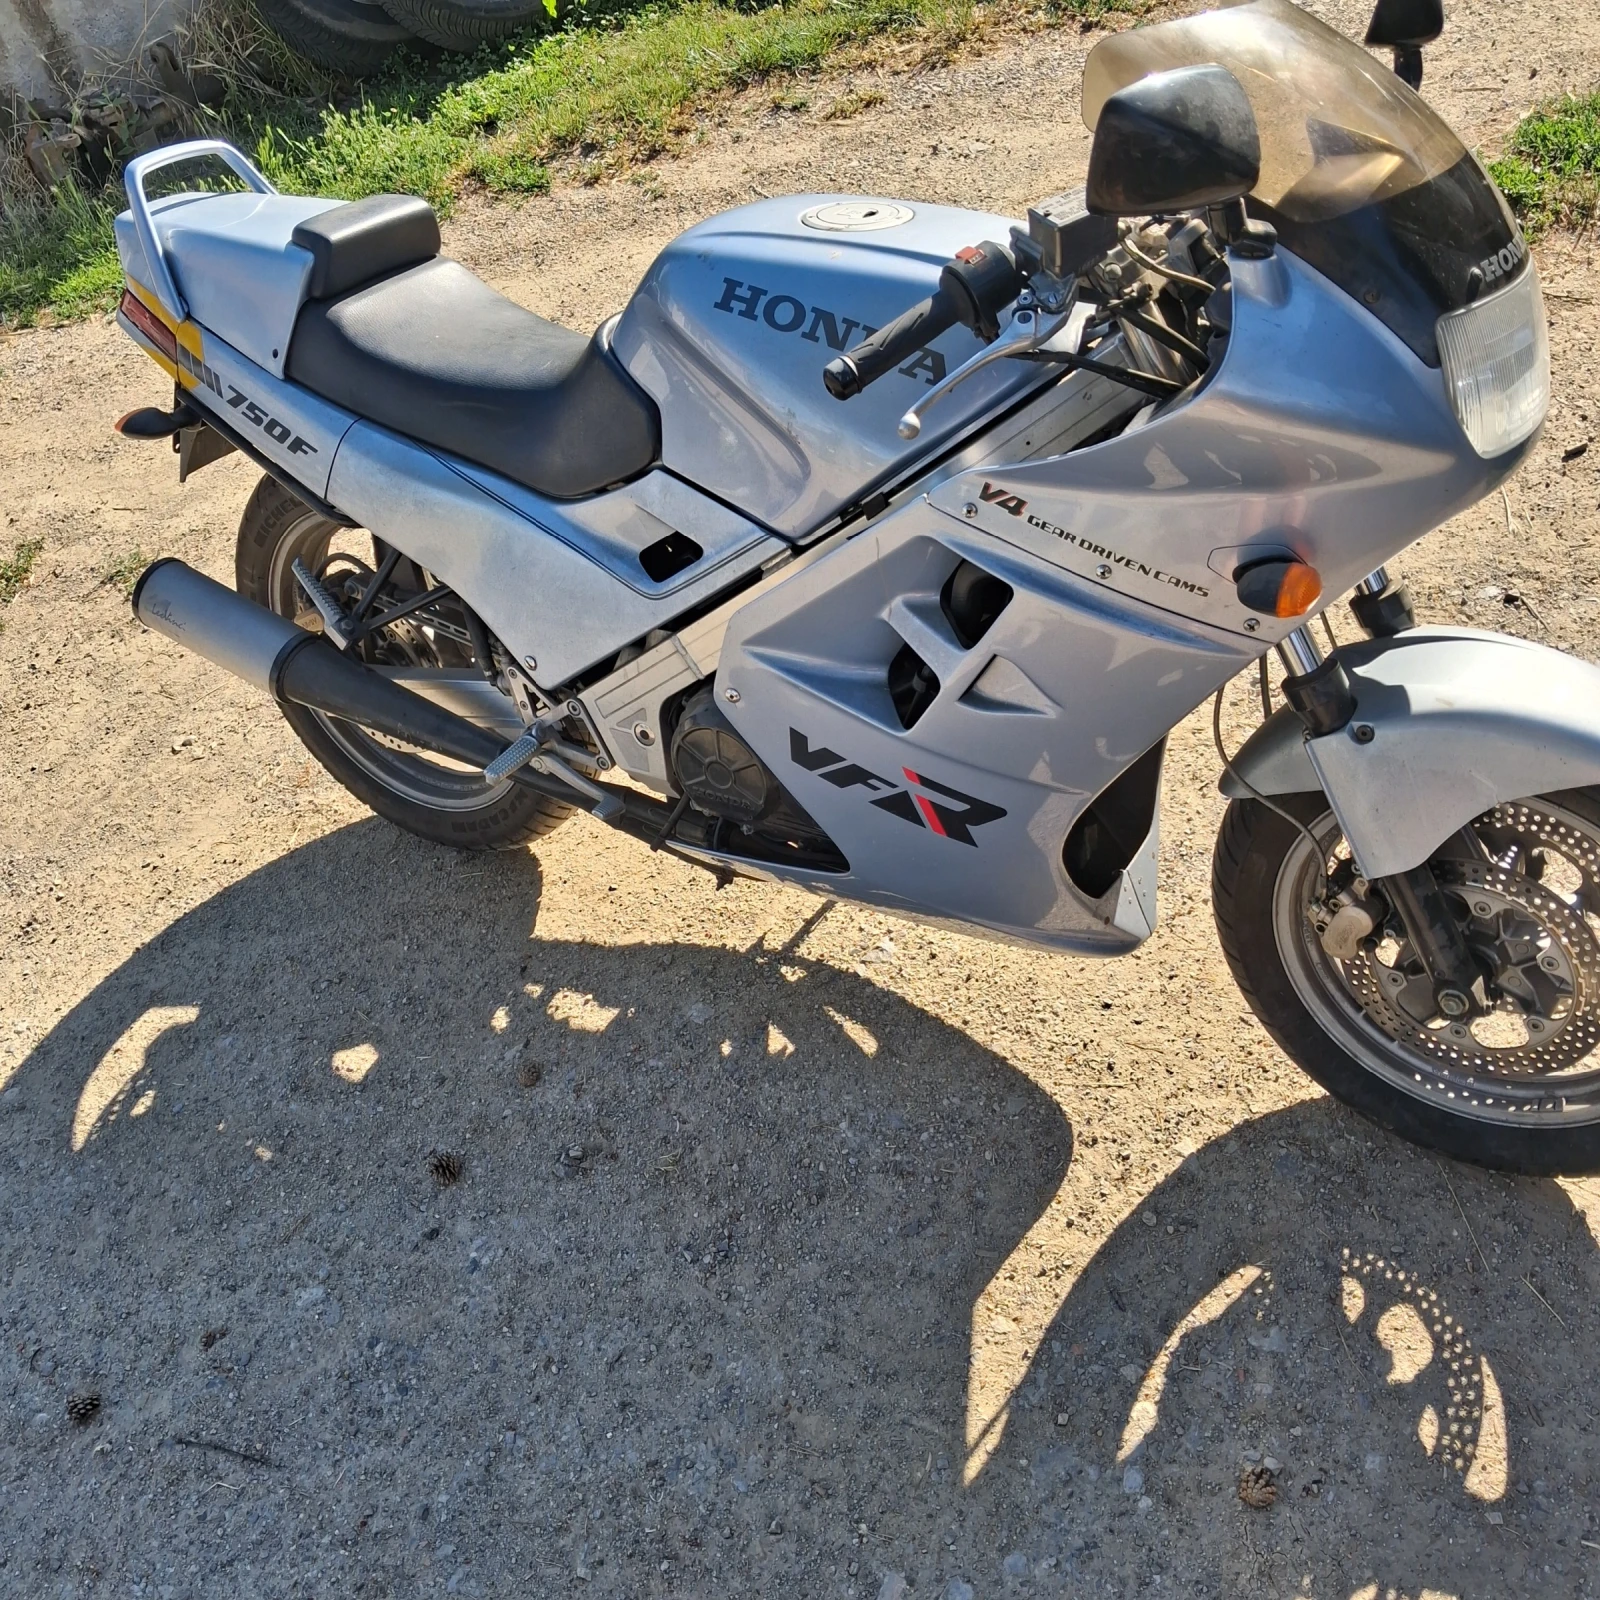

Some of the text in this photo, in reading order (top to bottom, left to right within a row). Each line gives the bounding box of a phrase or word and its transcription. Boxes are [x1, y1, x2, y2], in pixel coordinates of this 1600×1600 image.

[713, 277, 947, 386] HONA
[226, 384, 319, 456] 750F
[978, 481, 1211, 598] V4 GEAR DRIVEN CAMS
[789, 726, 1008, 848] VFR
